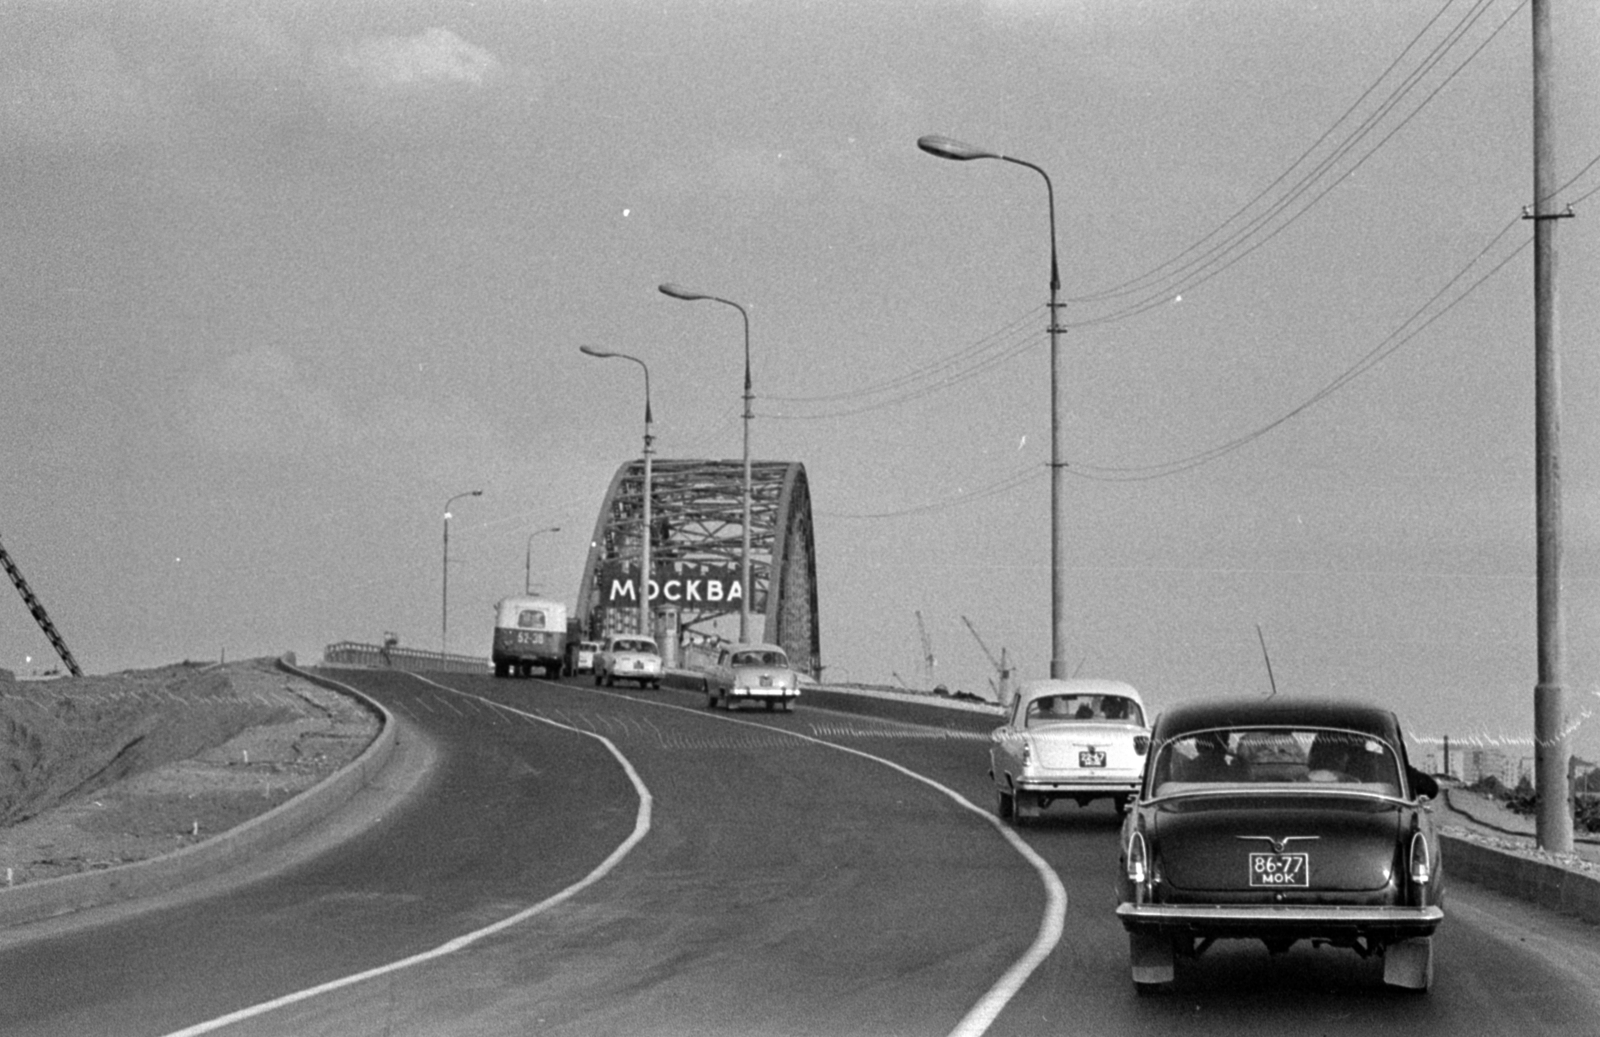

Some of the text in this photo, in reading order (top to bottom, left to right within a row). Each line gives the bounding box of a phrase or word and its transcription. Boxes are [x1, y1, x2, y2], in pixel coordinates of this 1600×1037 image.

[609, 579, 742, 601] МОСКВА
[1254, 856, 1303, 873] 86-77
[1262, 872, 1295, 883] МОК
